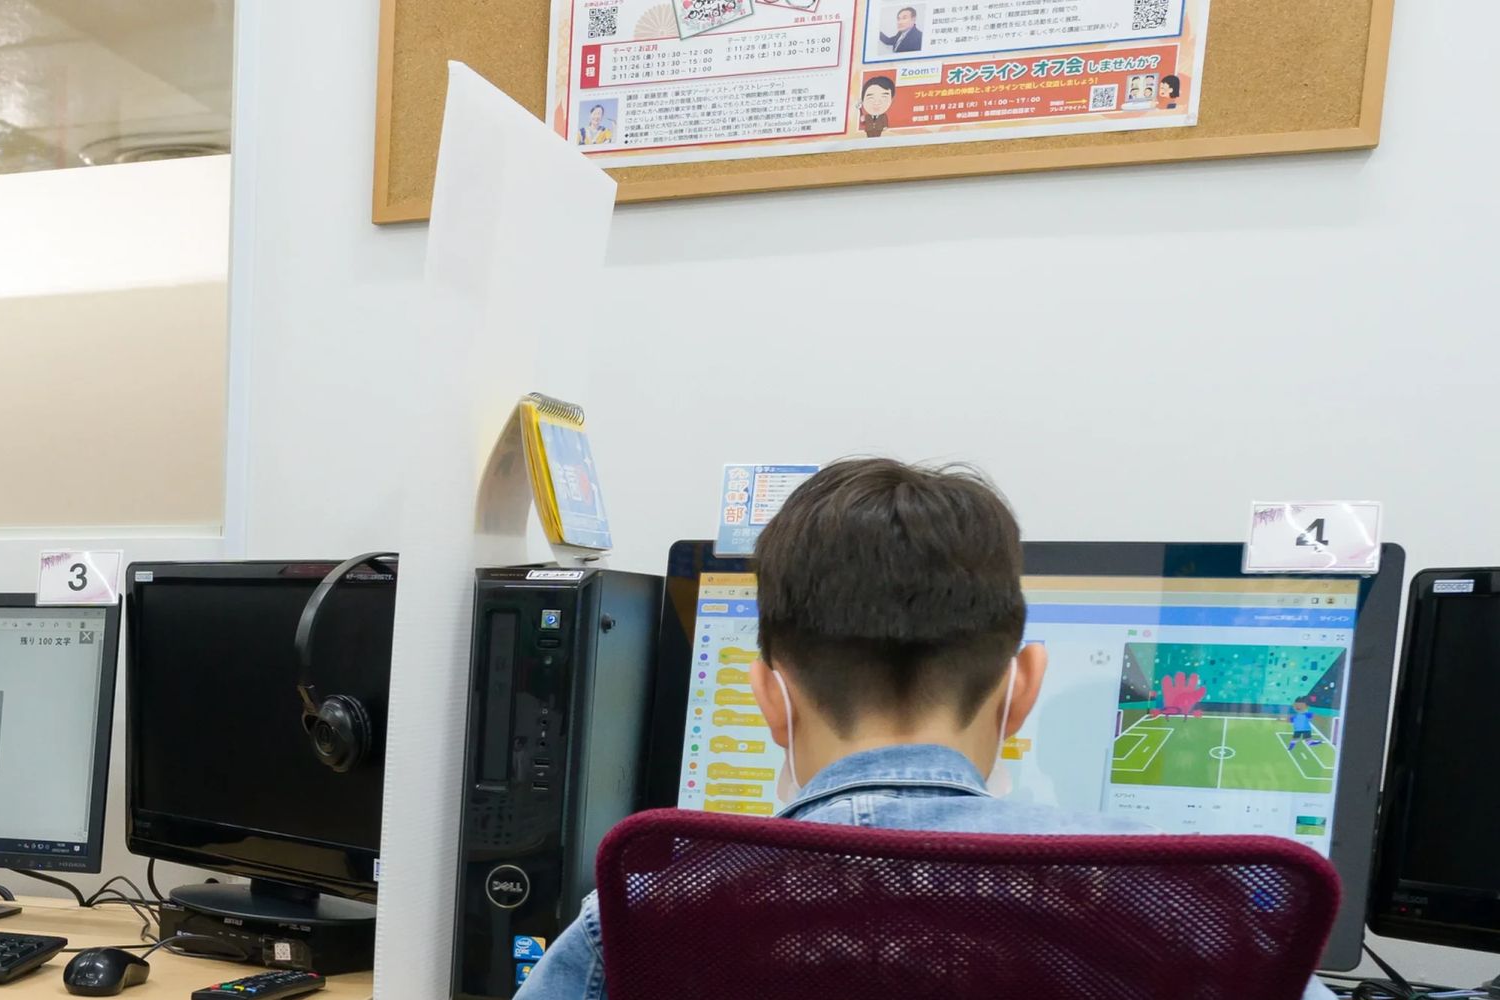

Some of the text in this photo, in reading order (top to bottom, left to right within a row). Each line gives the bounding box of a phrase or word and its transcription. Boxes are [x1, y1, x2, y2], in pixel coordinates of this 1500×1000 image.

[948, 63, 1027, 84] オンライン
[1032, 57, 1084, 76] オフ会
[725, 506, 745, 524] 部
[67, 562, 88, 592] 3
[55, 636, 71, 646] 文字
[492, 880, 523, 893] DELL
